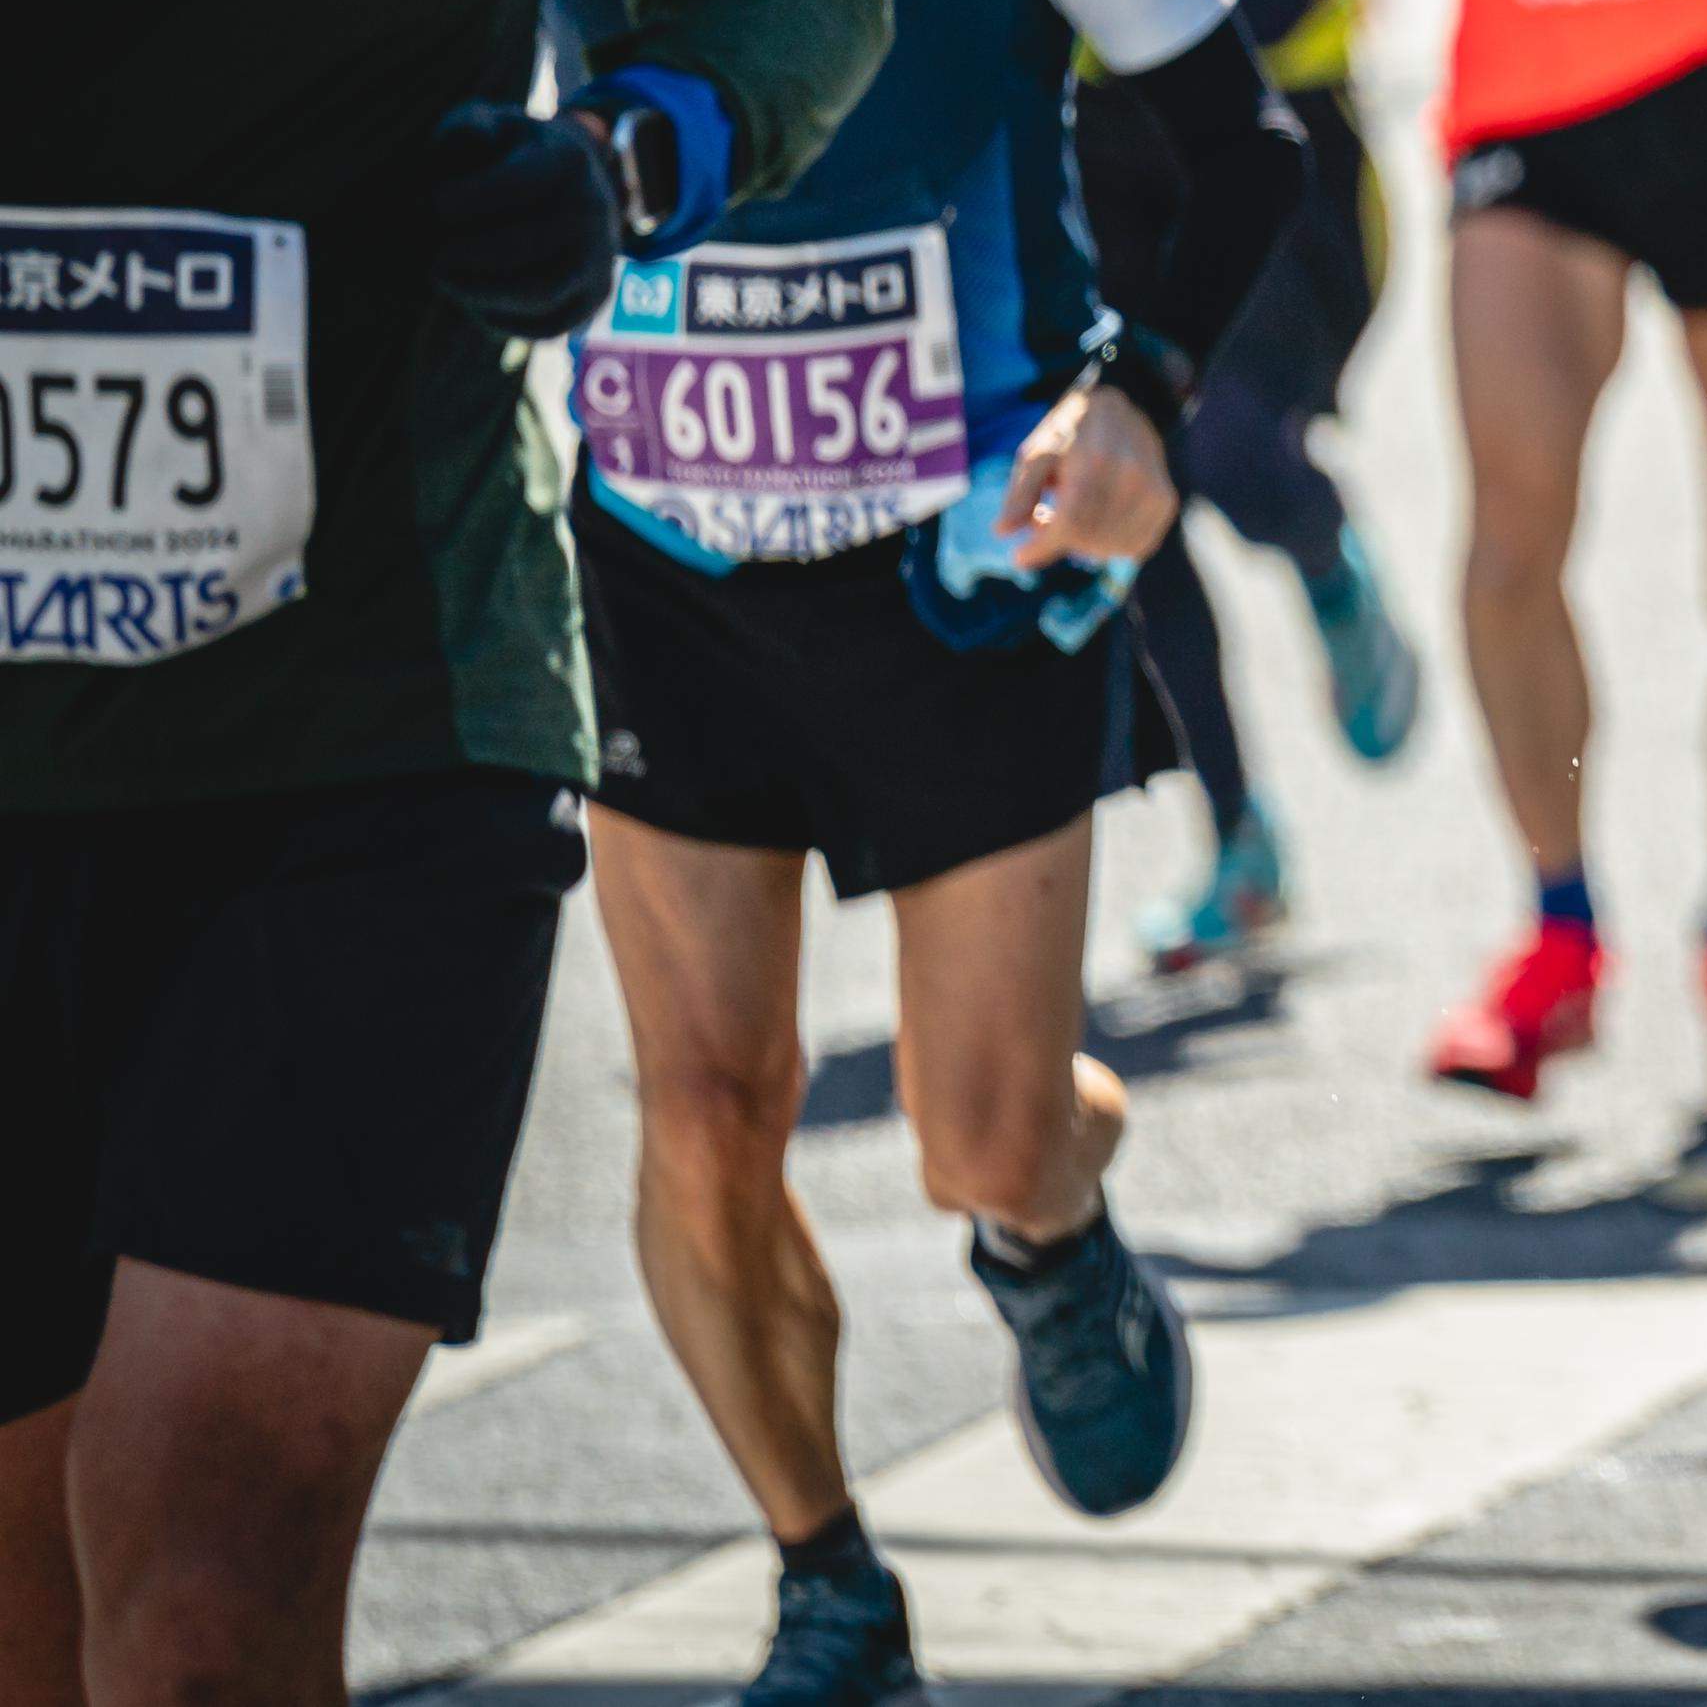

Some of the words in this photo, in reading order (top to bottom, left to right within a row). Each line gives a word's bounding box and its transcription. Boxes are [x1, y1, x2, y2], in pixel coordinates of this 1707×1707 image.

[0, 249, 234, 311] 京メトロ
[696, 262, 906, 327] 東京メトロ
[583, 357, 633, 417] C
[659, 346, 909, 465] 60156
[0, 372, 224, 511] 579
